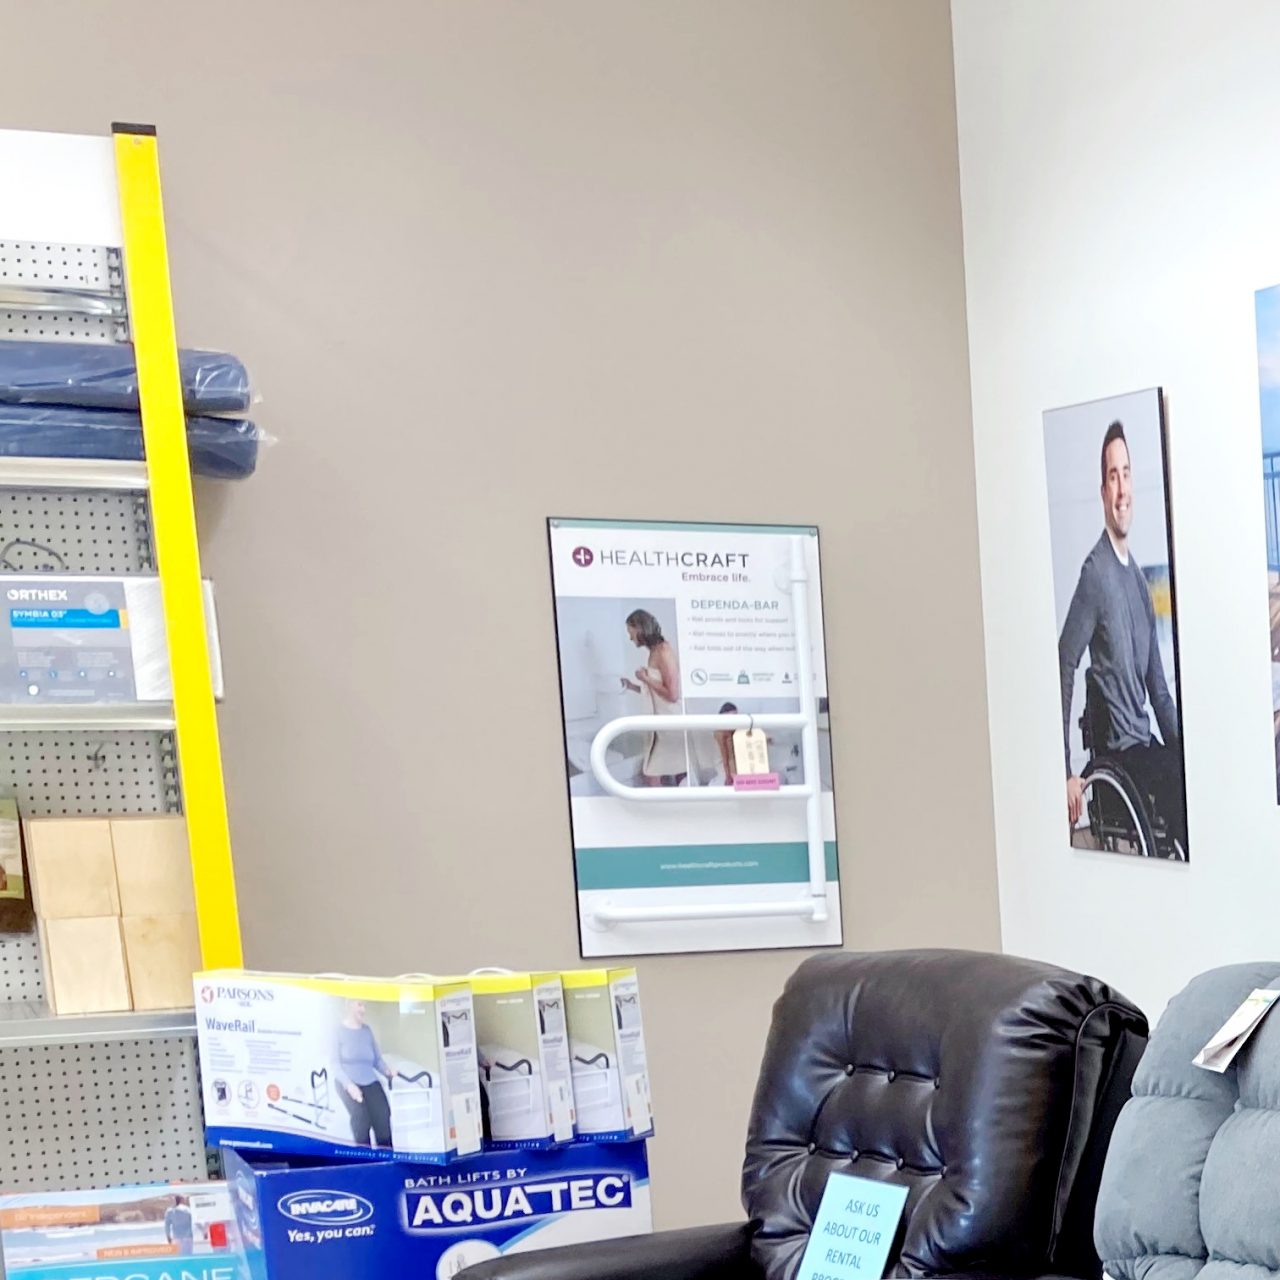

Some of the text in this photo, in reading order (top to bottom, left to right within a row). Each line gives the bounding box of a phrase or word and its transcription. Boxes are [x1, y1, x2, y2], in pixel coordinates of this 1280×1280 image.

[600, 549, 750, 568] HEALTHCRAFT
[681, 571, 751, 582] Embrace life.
[7, 589, 68, 600] ORTHEX
[691, 599, 779, 610] DEPENDA-BAR
[217, 986, 275, 1001] PARSONS
[205, 1017, 256, 1034] WaveRail
[405, 1168, 528, 1188] BATH LIFTS BY
[845, 1199, 881, 1218] ASK US
[287, 1229, 315, 1243] Yes,
[316, 1230, 343, 1243] you
[823, 1221, 881, 1245] ABOUT OUR
[825, 1248, 862, 1269] RENTAL
